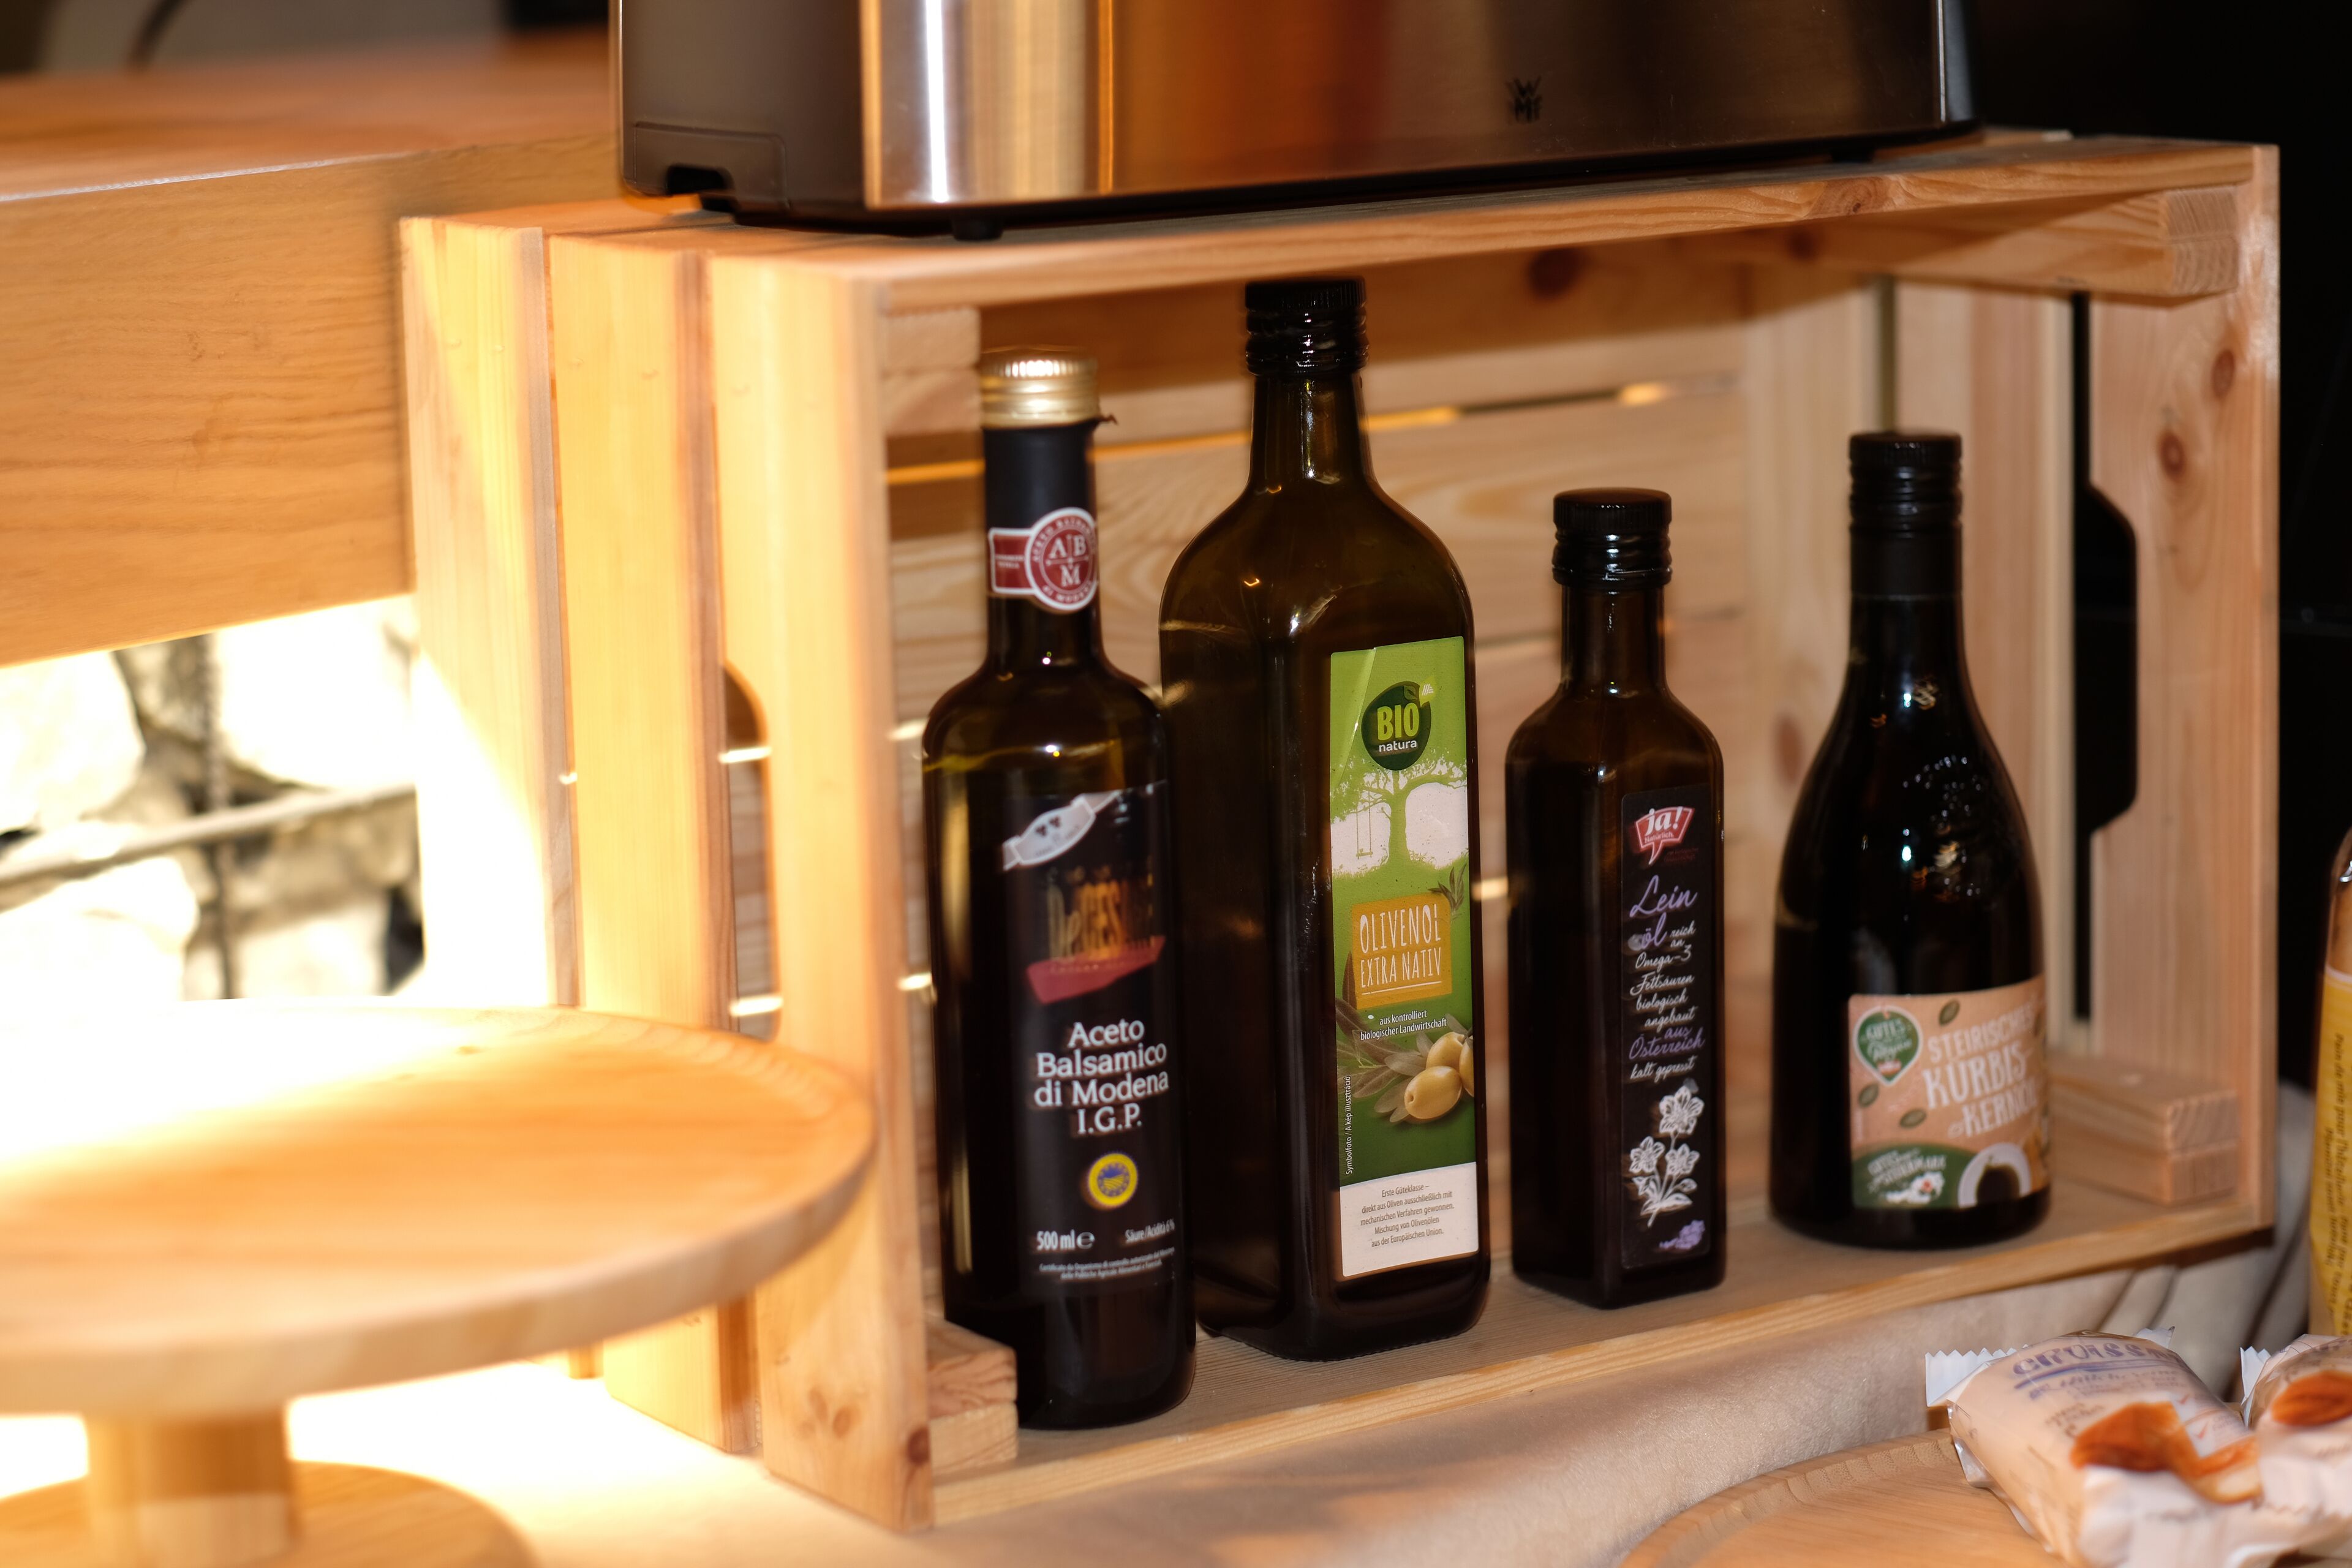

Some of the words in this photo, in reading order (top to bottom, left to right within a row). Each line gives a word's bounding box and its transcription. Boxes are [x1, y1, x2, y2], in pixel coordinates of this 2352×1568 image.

[1377, 703, 1419, 741] BIO
[1379, 739, 1417, 752] natura
[1629, 875, 1698, 918] Lein
[1670, 920, 1696, 938] reich
[1670, 938, 1685, 948] an
[1361, 954, 1396, 988] EXTRA
[1402, 947, 1441, 981] NATIV
[1635, 944, 1692, 973] Omega-3
[1630, 971, 1695, 996] Fettsäuren
[1636, 987, 1688, 1014] biologisch
[1360, 1027, 1398, 1041] biologischer
[1400, 1017, 1447, 1034] Landwirtschaft
[1379, 1017, 1390, 1025] aus
[1392, 1010, 1427, 1023] kontrolliert
[1645, 1006, 1699, 1033] angebaut
[1067, 1018, 1145, 1048] Aceto
[1629, 1027, 1706, 1060] Österreich
[1664, 1026, 1692, 1039] aus
[1036, 1042, 1167, 1077] Balsamico
[1630, 1061, 1657, 1079] kalt
[1034, 1078, 1063, 1107] di
[1071, 1071, 1169, 1106] Modena
[1343, 1076, 1352, 1112] illusztráció
[1077, 1102, 1142, 1134] I.G.P.
[1344, 1113, 1353, 1126] kép
[1346, 1137, 1354, 1175] Symbolfoto
[1395, 1184, 1424, 1194] Güteklasse
[1360, 1213, 1396, 1226] mechanischen
[1396, 1207, 1423, 1218] Verfahren
[1424, 1203, 1455, 1215] gewonnen.
[1362, 1204, 1376, 1214] direkt
[1387, 1199, 1403, 1208] Oliven
[1404, 1193, 1442, 1205] ausschließlich
[1374, 1223, 1399, 1235] Mischung
[1411, 1216, 1439, 1227] Olivenölen
[1037, 1231, 1058, 1251] 500
[1060, 1229, 1075, 1250] ml
[1371, 1239, 1381, 1248] aus
[1381, 1237, 1390, 1245] der
[1390, 1231, 1425, 1243] Europäischen
